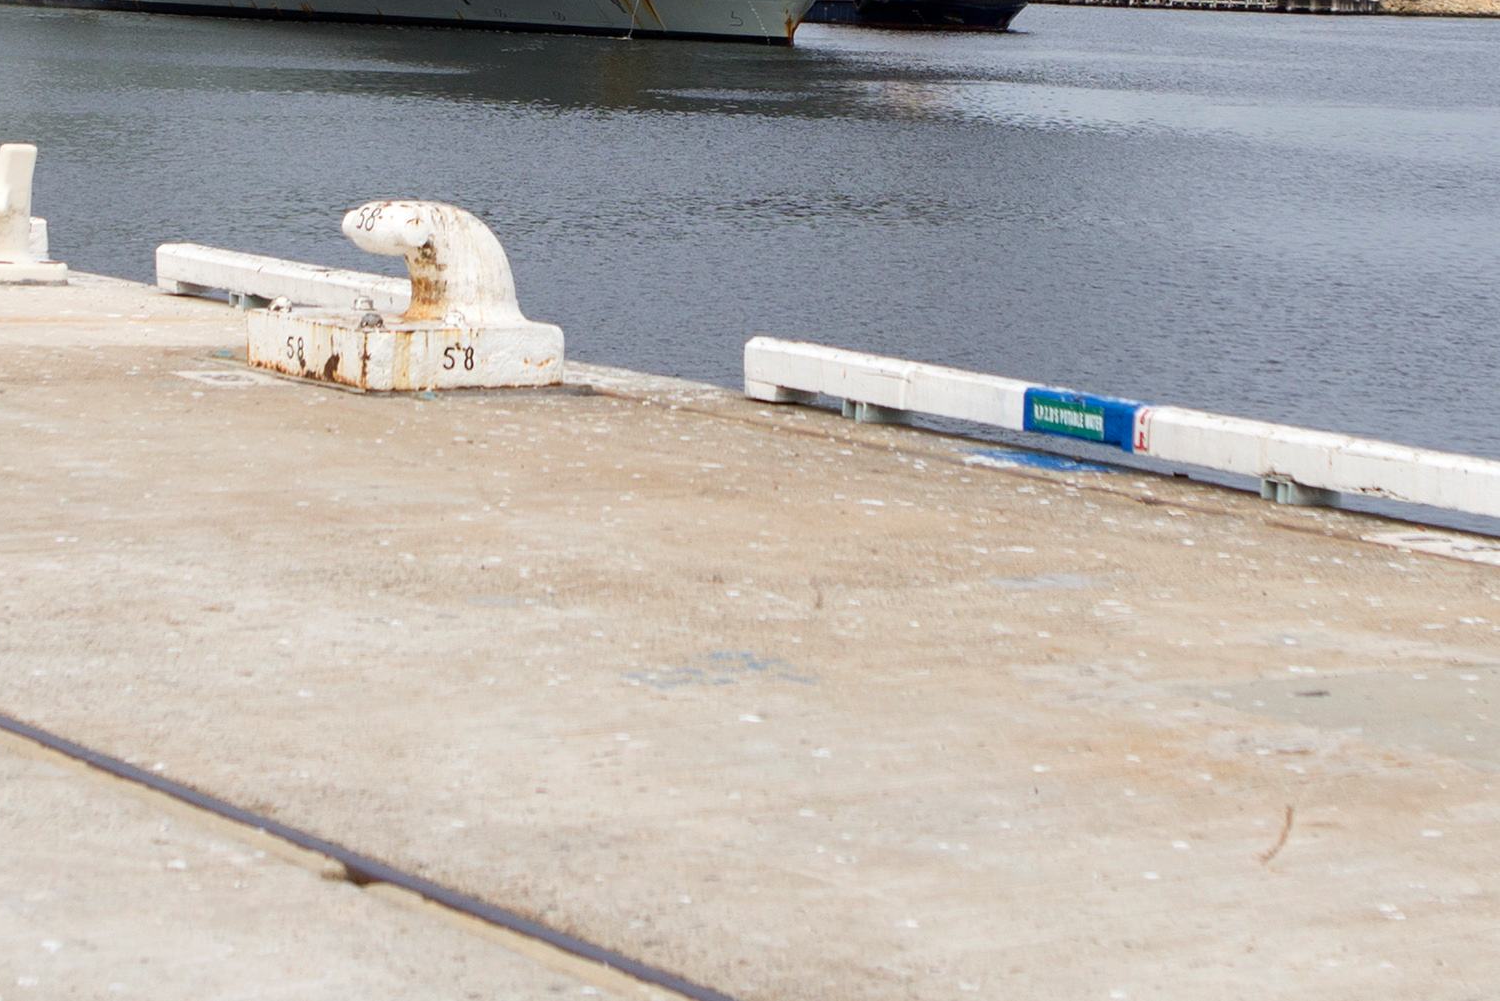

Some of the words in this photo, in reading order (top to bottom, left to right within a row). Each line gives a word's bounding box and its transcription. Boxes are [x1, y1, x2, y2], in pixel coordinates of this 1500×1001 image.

[355, 206, 382, 231] 58
[286, 336, 305, 361] 58
[442, 346, 475, 371] 58
[1059, 408, 1084, 429] POTABLE
[1084, 413, 1103, 432] WATER
